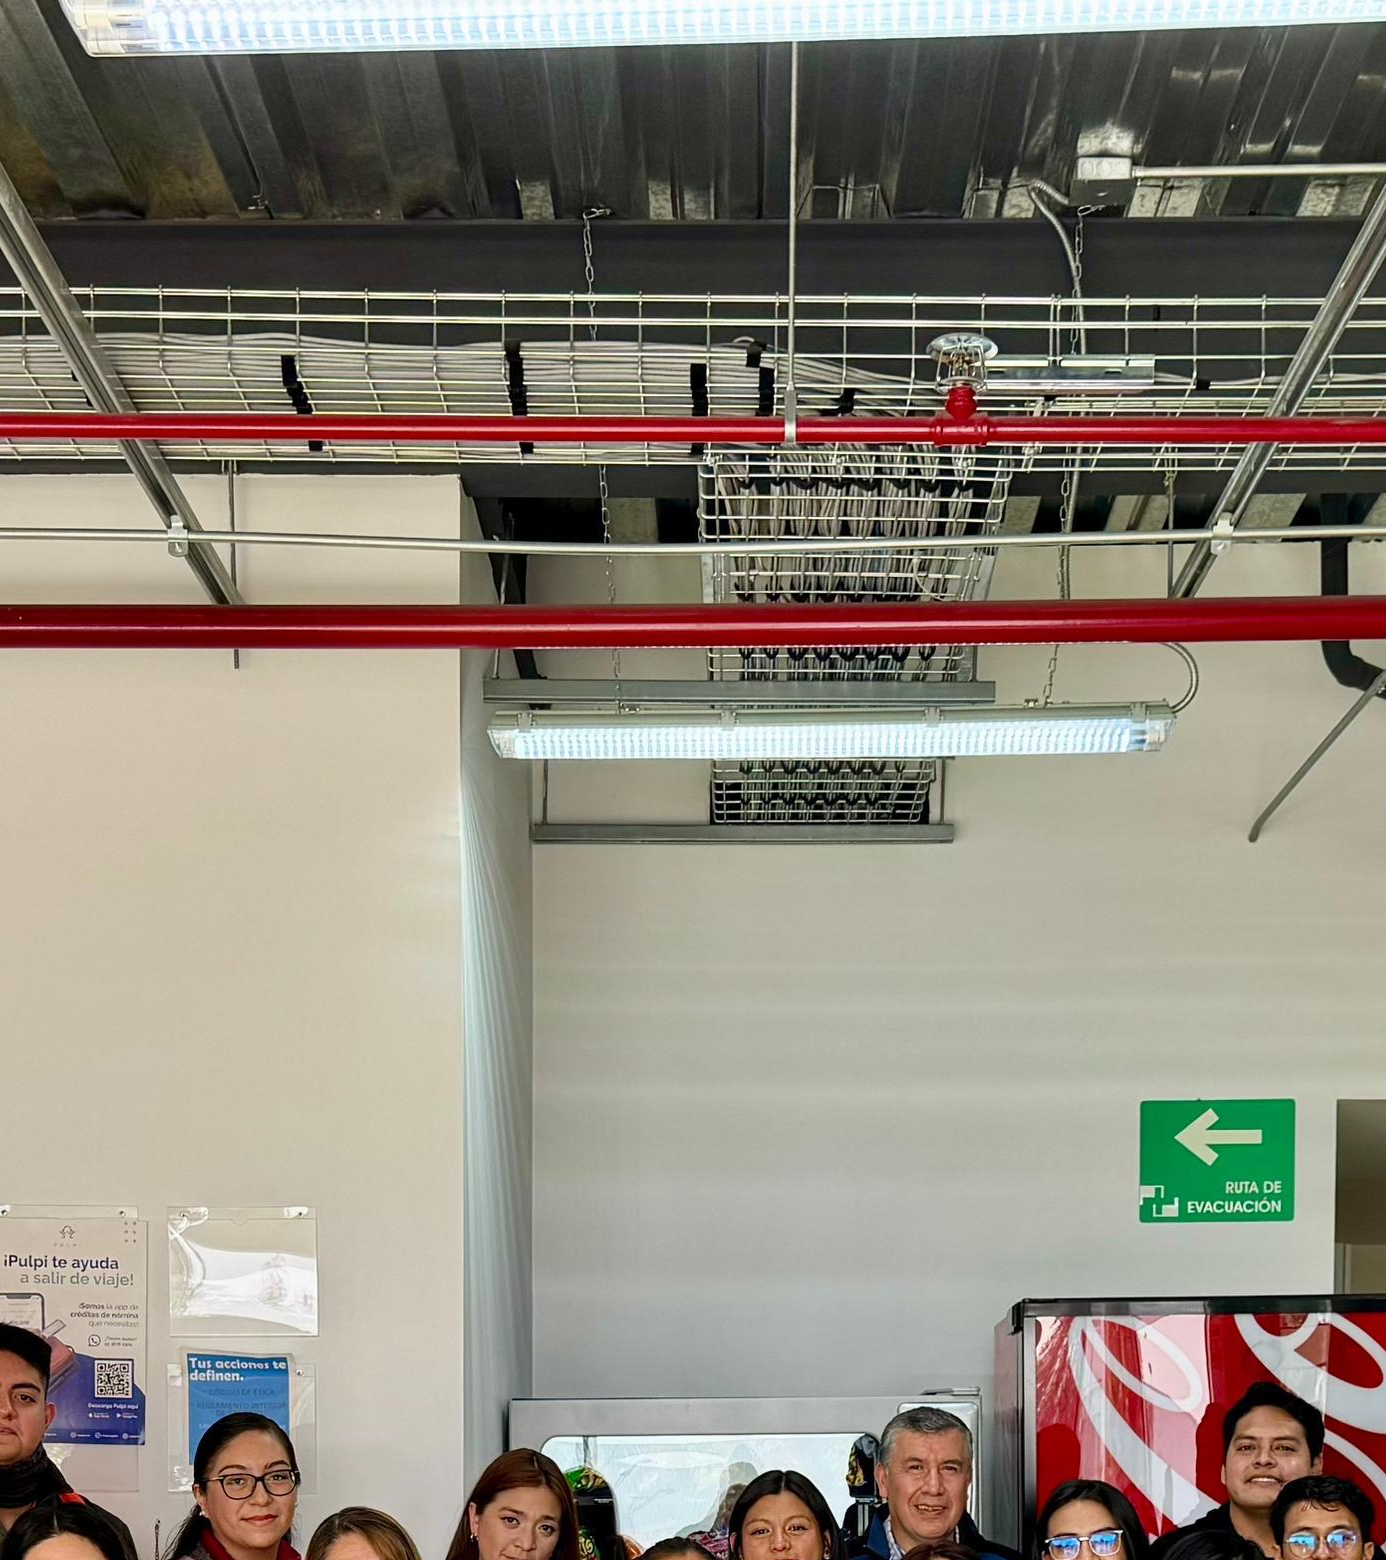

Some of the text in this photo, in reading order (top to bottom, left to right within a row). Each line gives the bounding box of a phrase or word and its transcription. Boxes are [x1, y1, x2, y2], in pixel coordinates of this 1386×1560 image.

[1225, 1181, 1282, 1194] RUTA DE
[1187, 1197, 1282, 1214] EVACUACIÓN
[4, 1254, 119, 1272] ¡Pulpi te ayuda
[20, 1271, 134, 1288] a salir de viaje!
[189, 1357, 287, 1370] Tus acciones te
[189, 1369, 244, 1382] definen.
